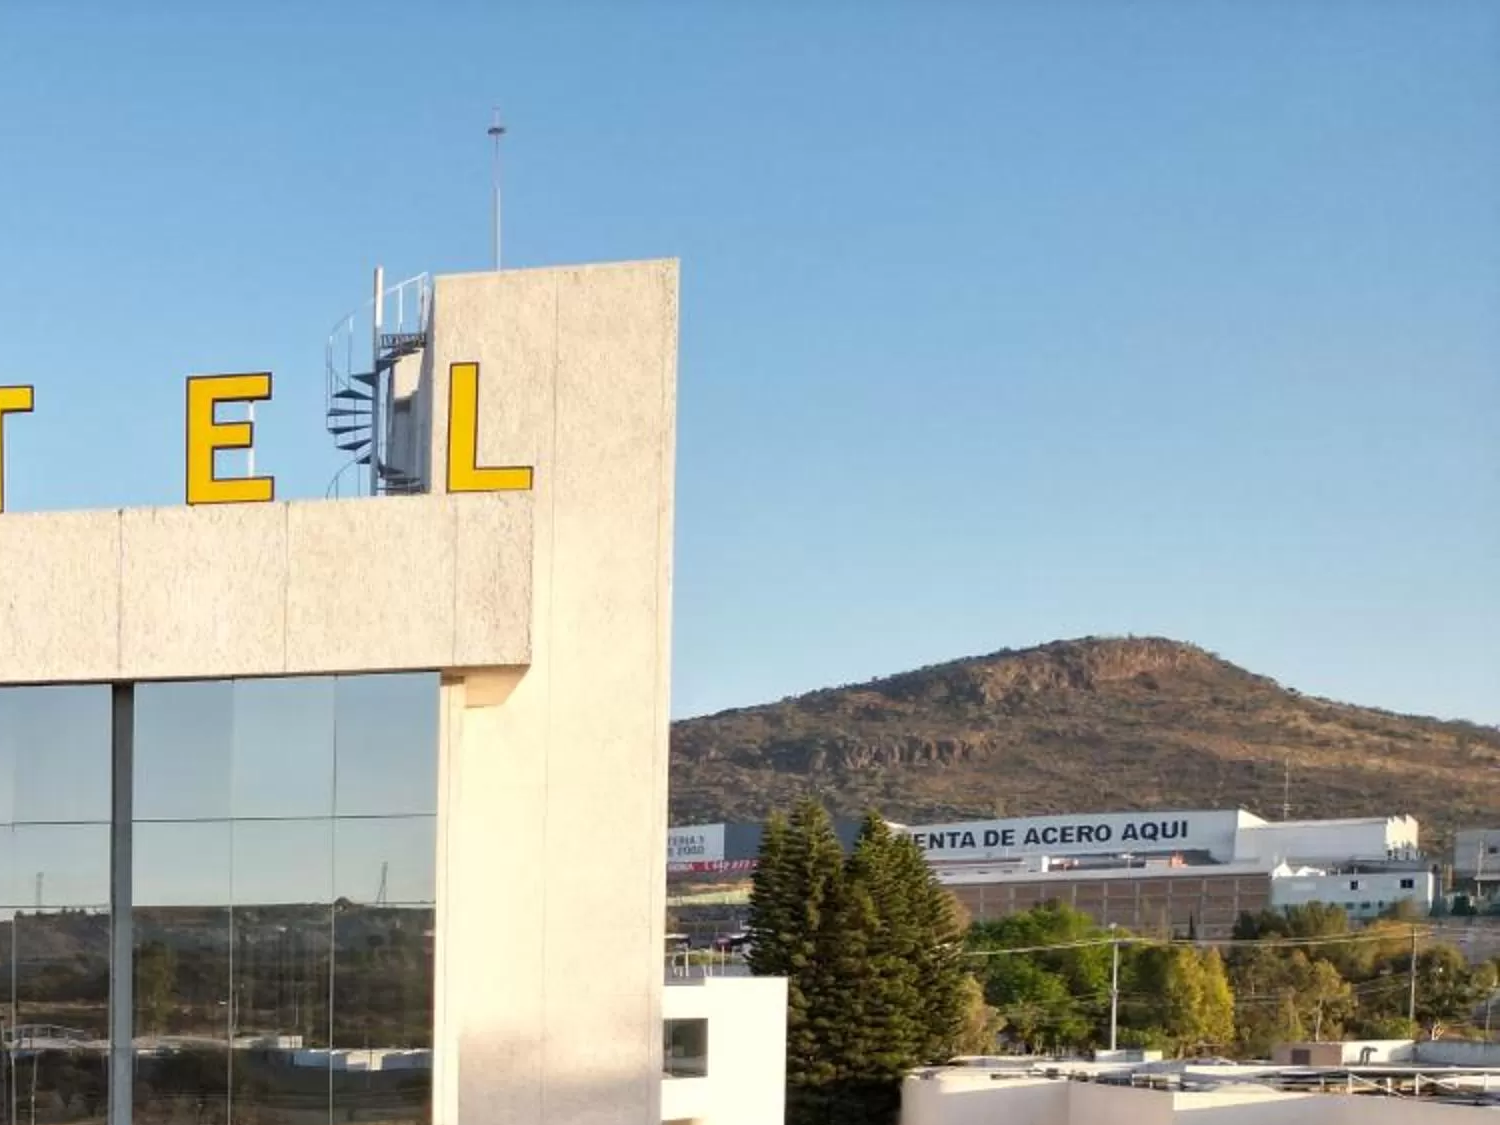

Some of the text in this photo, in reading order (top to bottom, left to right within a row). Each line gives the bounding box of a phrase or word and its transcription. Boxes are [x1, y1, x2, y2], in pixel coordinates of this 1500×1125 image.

[983, 828, 1015, 847] DE
[1023, 823, 1112, 846] ACERO
[1121, 819, 1189, 842] AQUI
